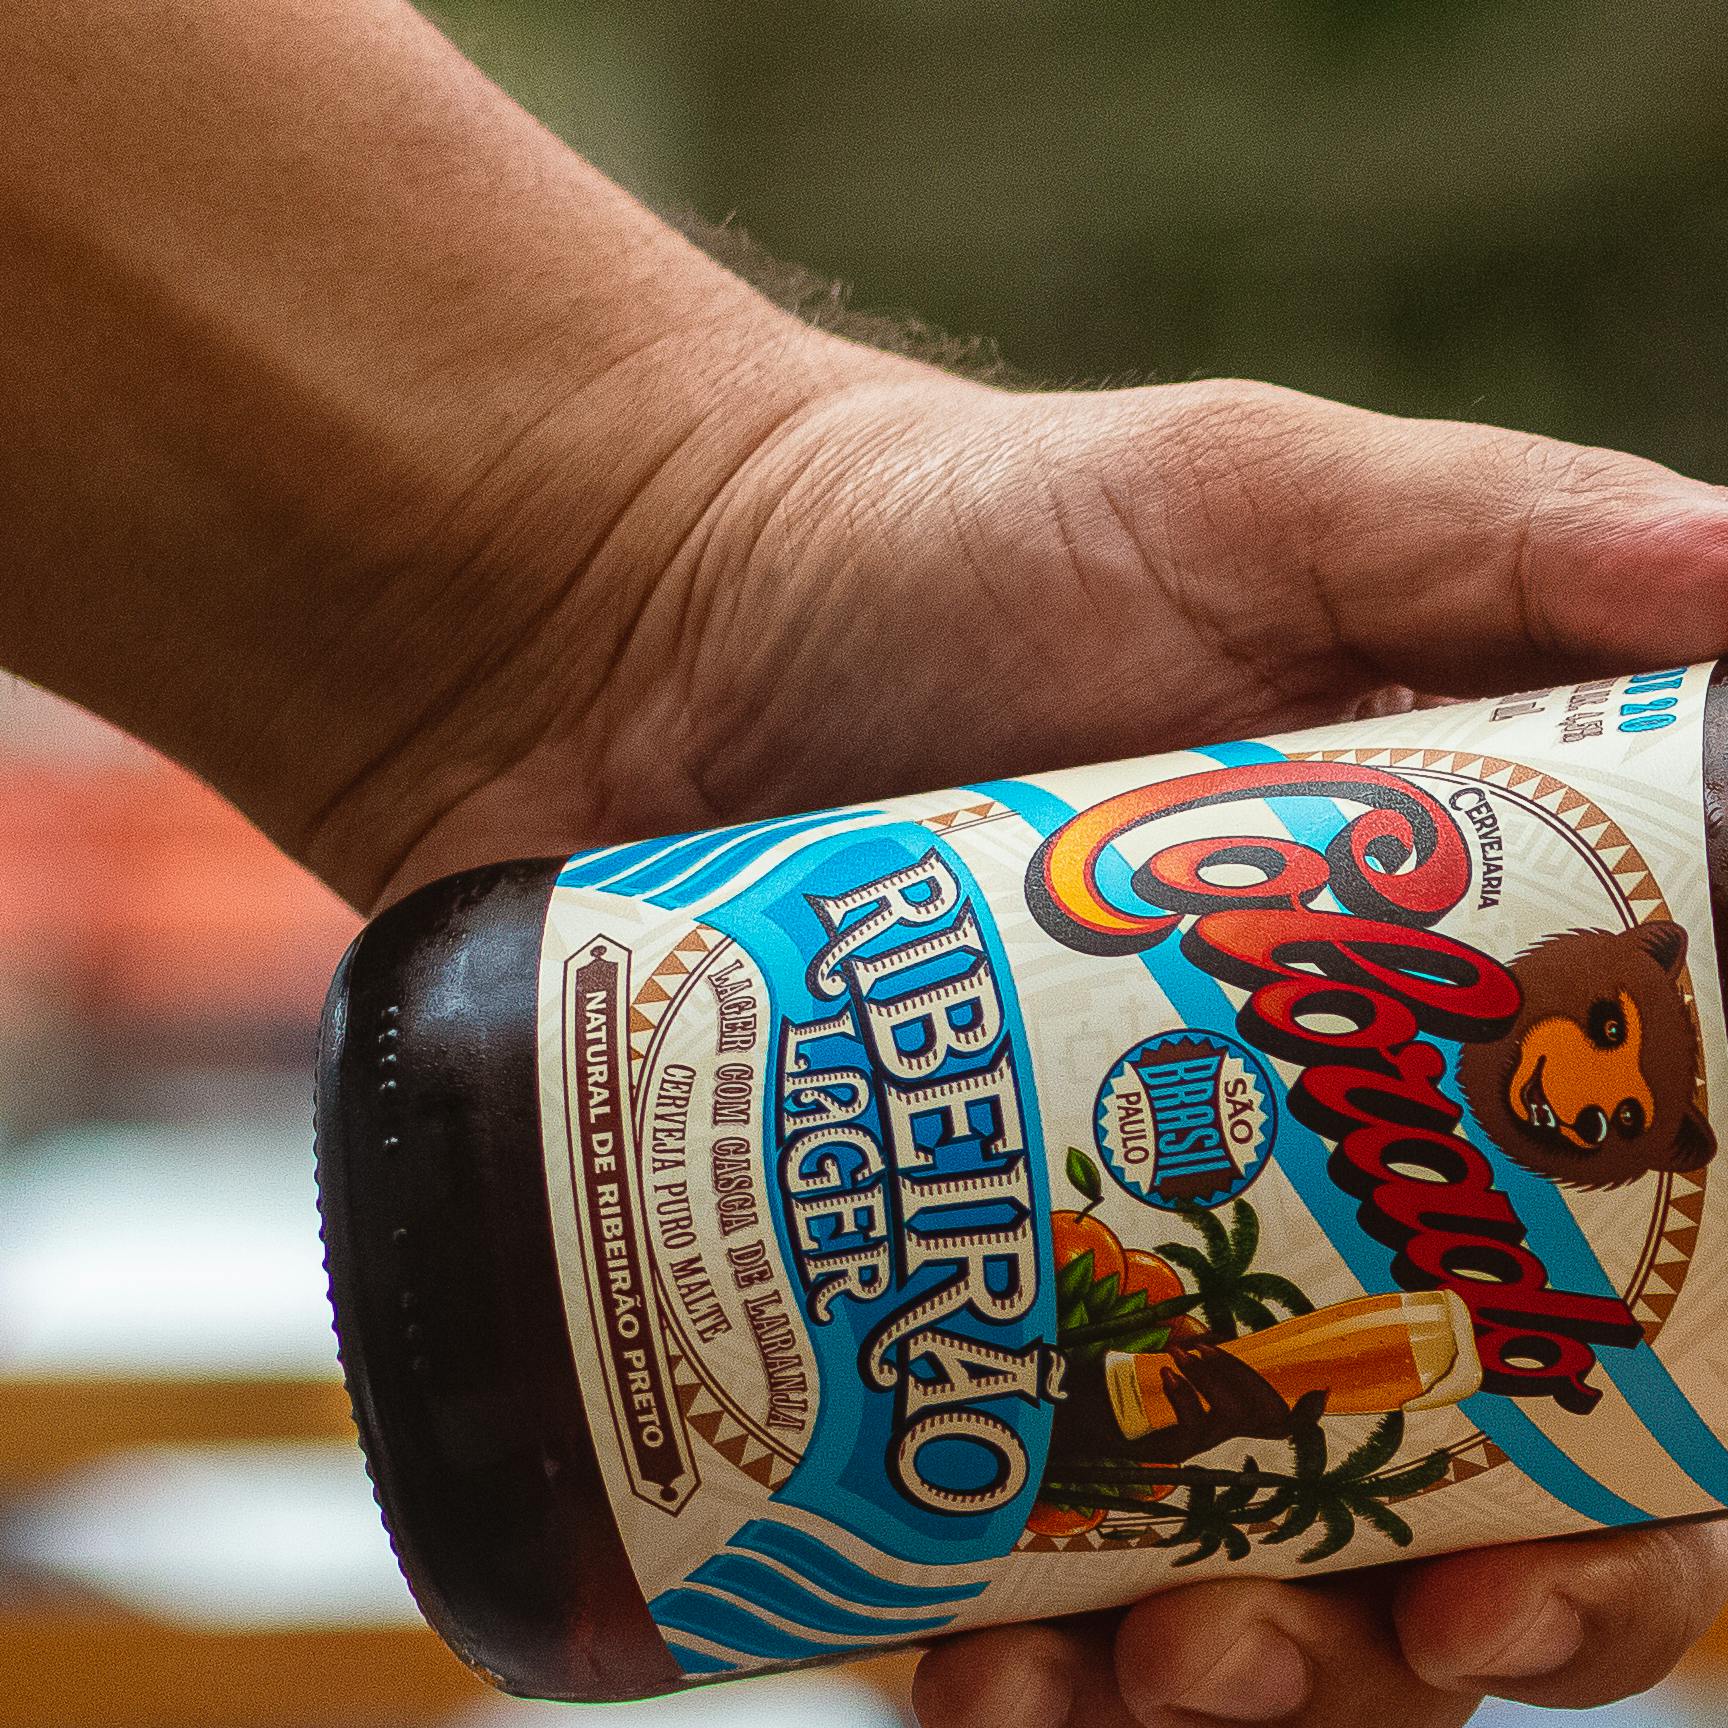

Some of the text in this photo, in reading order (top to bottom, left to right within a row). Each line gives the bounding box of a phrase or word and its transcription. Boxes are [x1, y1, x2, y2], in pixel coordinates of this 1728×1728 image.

[1449, 786, 1504, 911] CERVEJARIA
[585, 990, 664, 1449] NATURAL DE RIBEIRÃO PRETO
[651, 1063, 733, 1344] CERVEJA PURO MALTE
[707, 958, 809, 1432] LAGER COM CASCA DE LARANJA
[777, 1003, 891, 1325] LAGER
[803, 847, 1068, 1516] RIBEIRÃO
[1024, 760, 1645, 1414] Colorado
[1115, 1091, 1150, 1165] PAULO
[1137, 1055, 1232, 1187] BRASIL
[1223, 1076, 1255, 1145] SÃO
